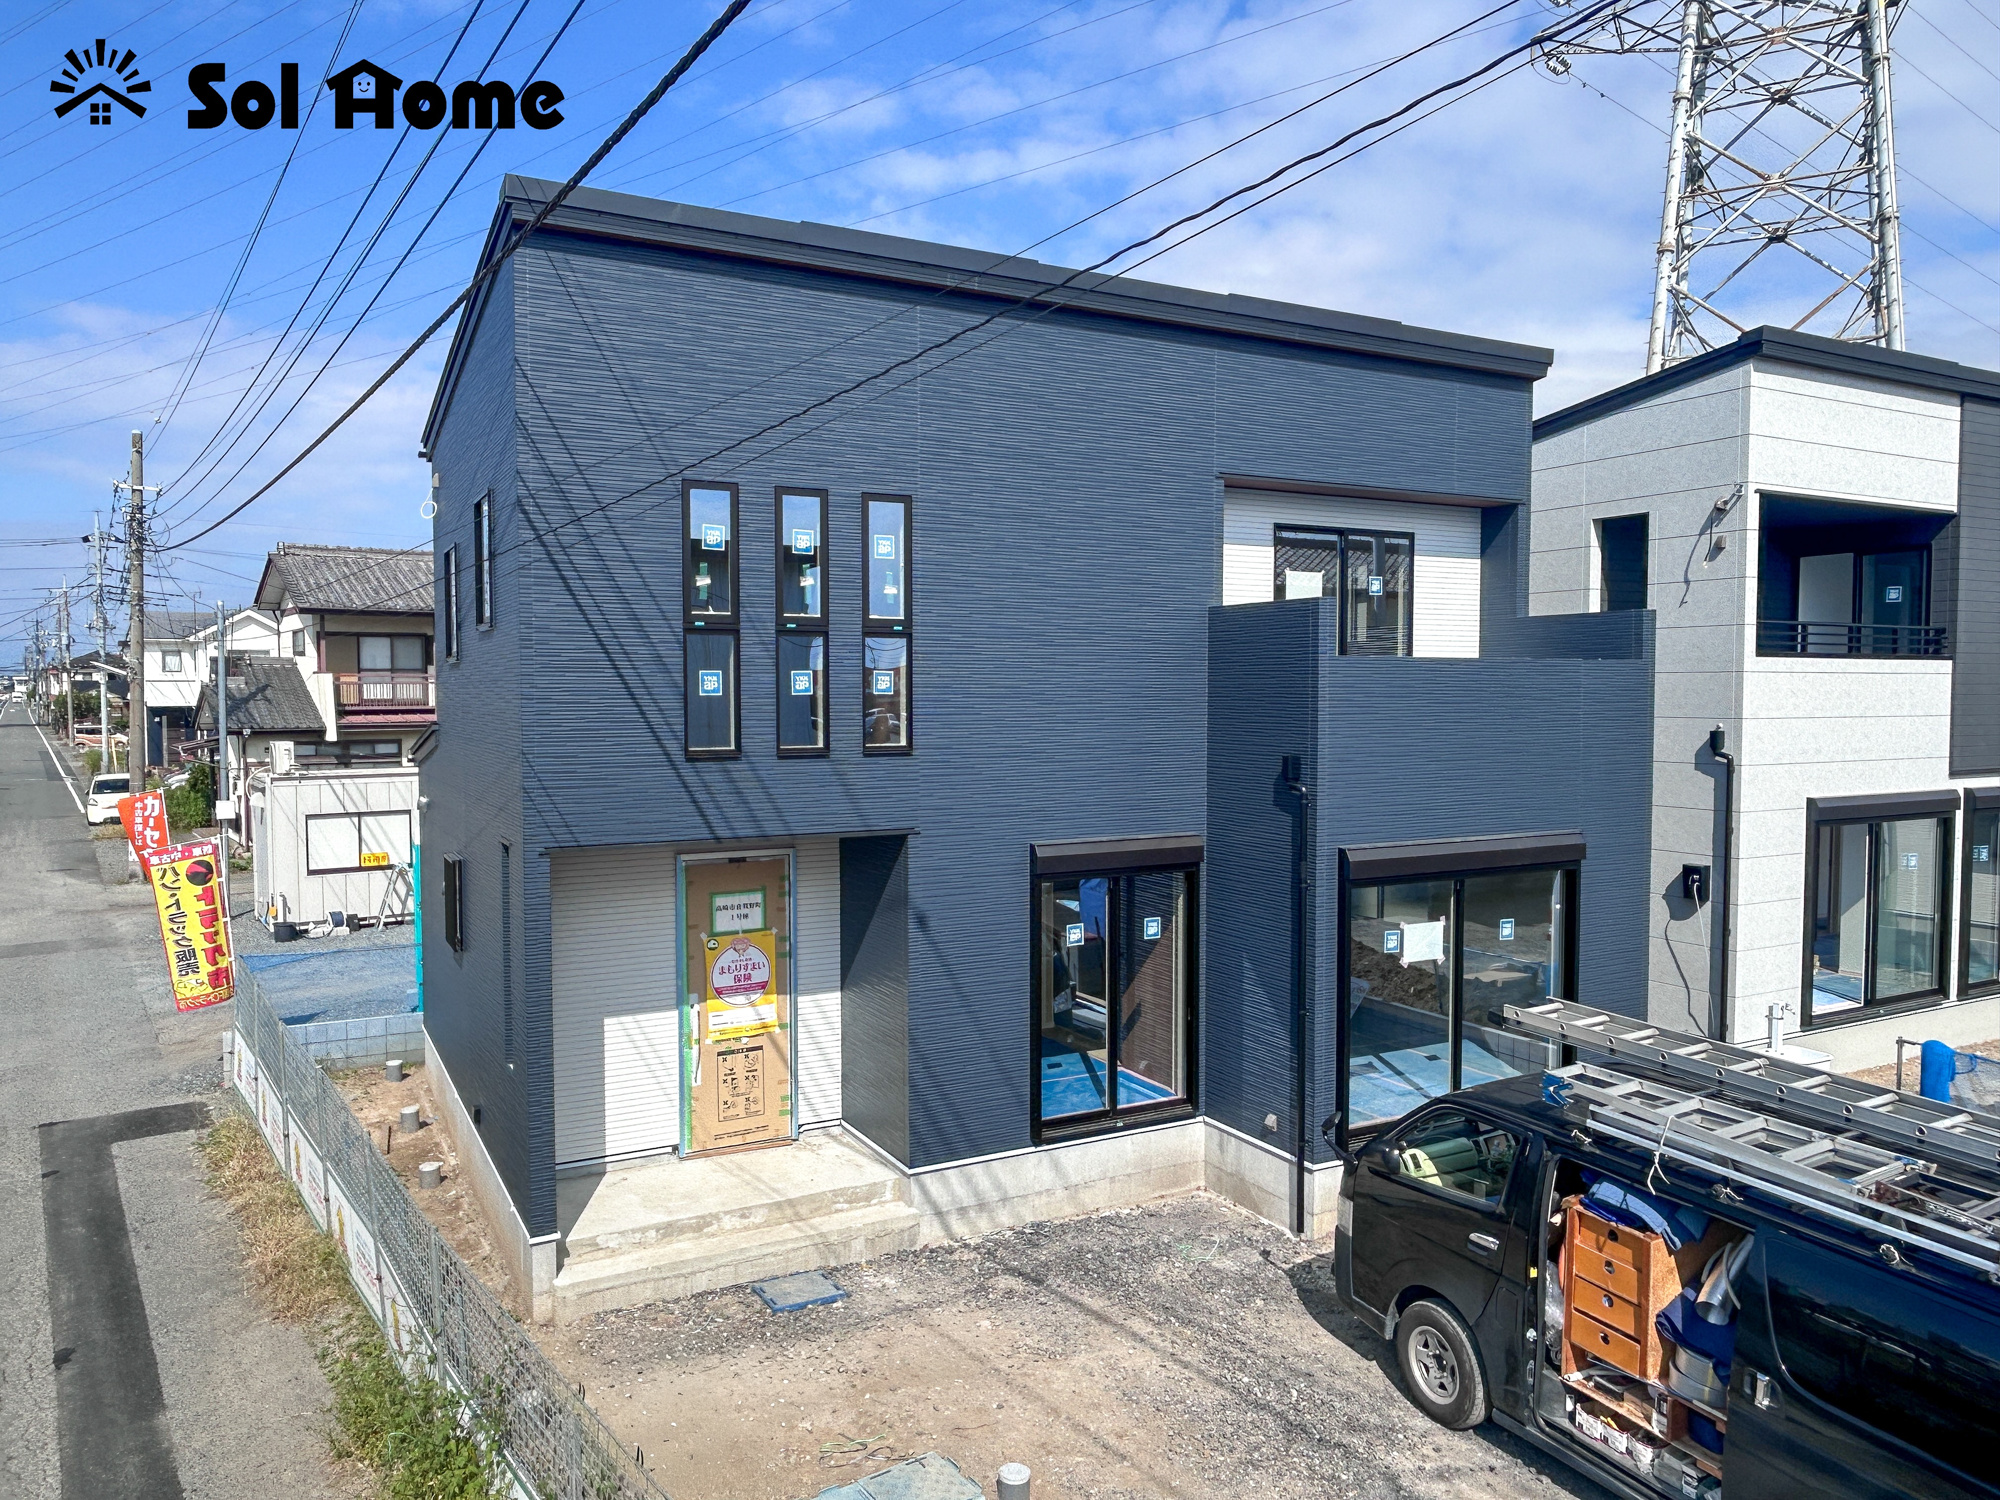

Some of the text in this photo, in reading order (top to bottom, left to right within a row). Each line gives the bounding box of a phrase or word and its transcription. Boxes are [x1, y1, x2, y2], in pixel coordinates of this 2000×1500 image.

[704, 681, 719, 690] ap
[718, 961, 766, 976] まもりすまい
[733, 972, 752, 984] 保険
